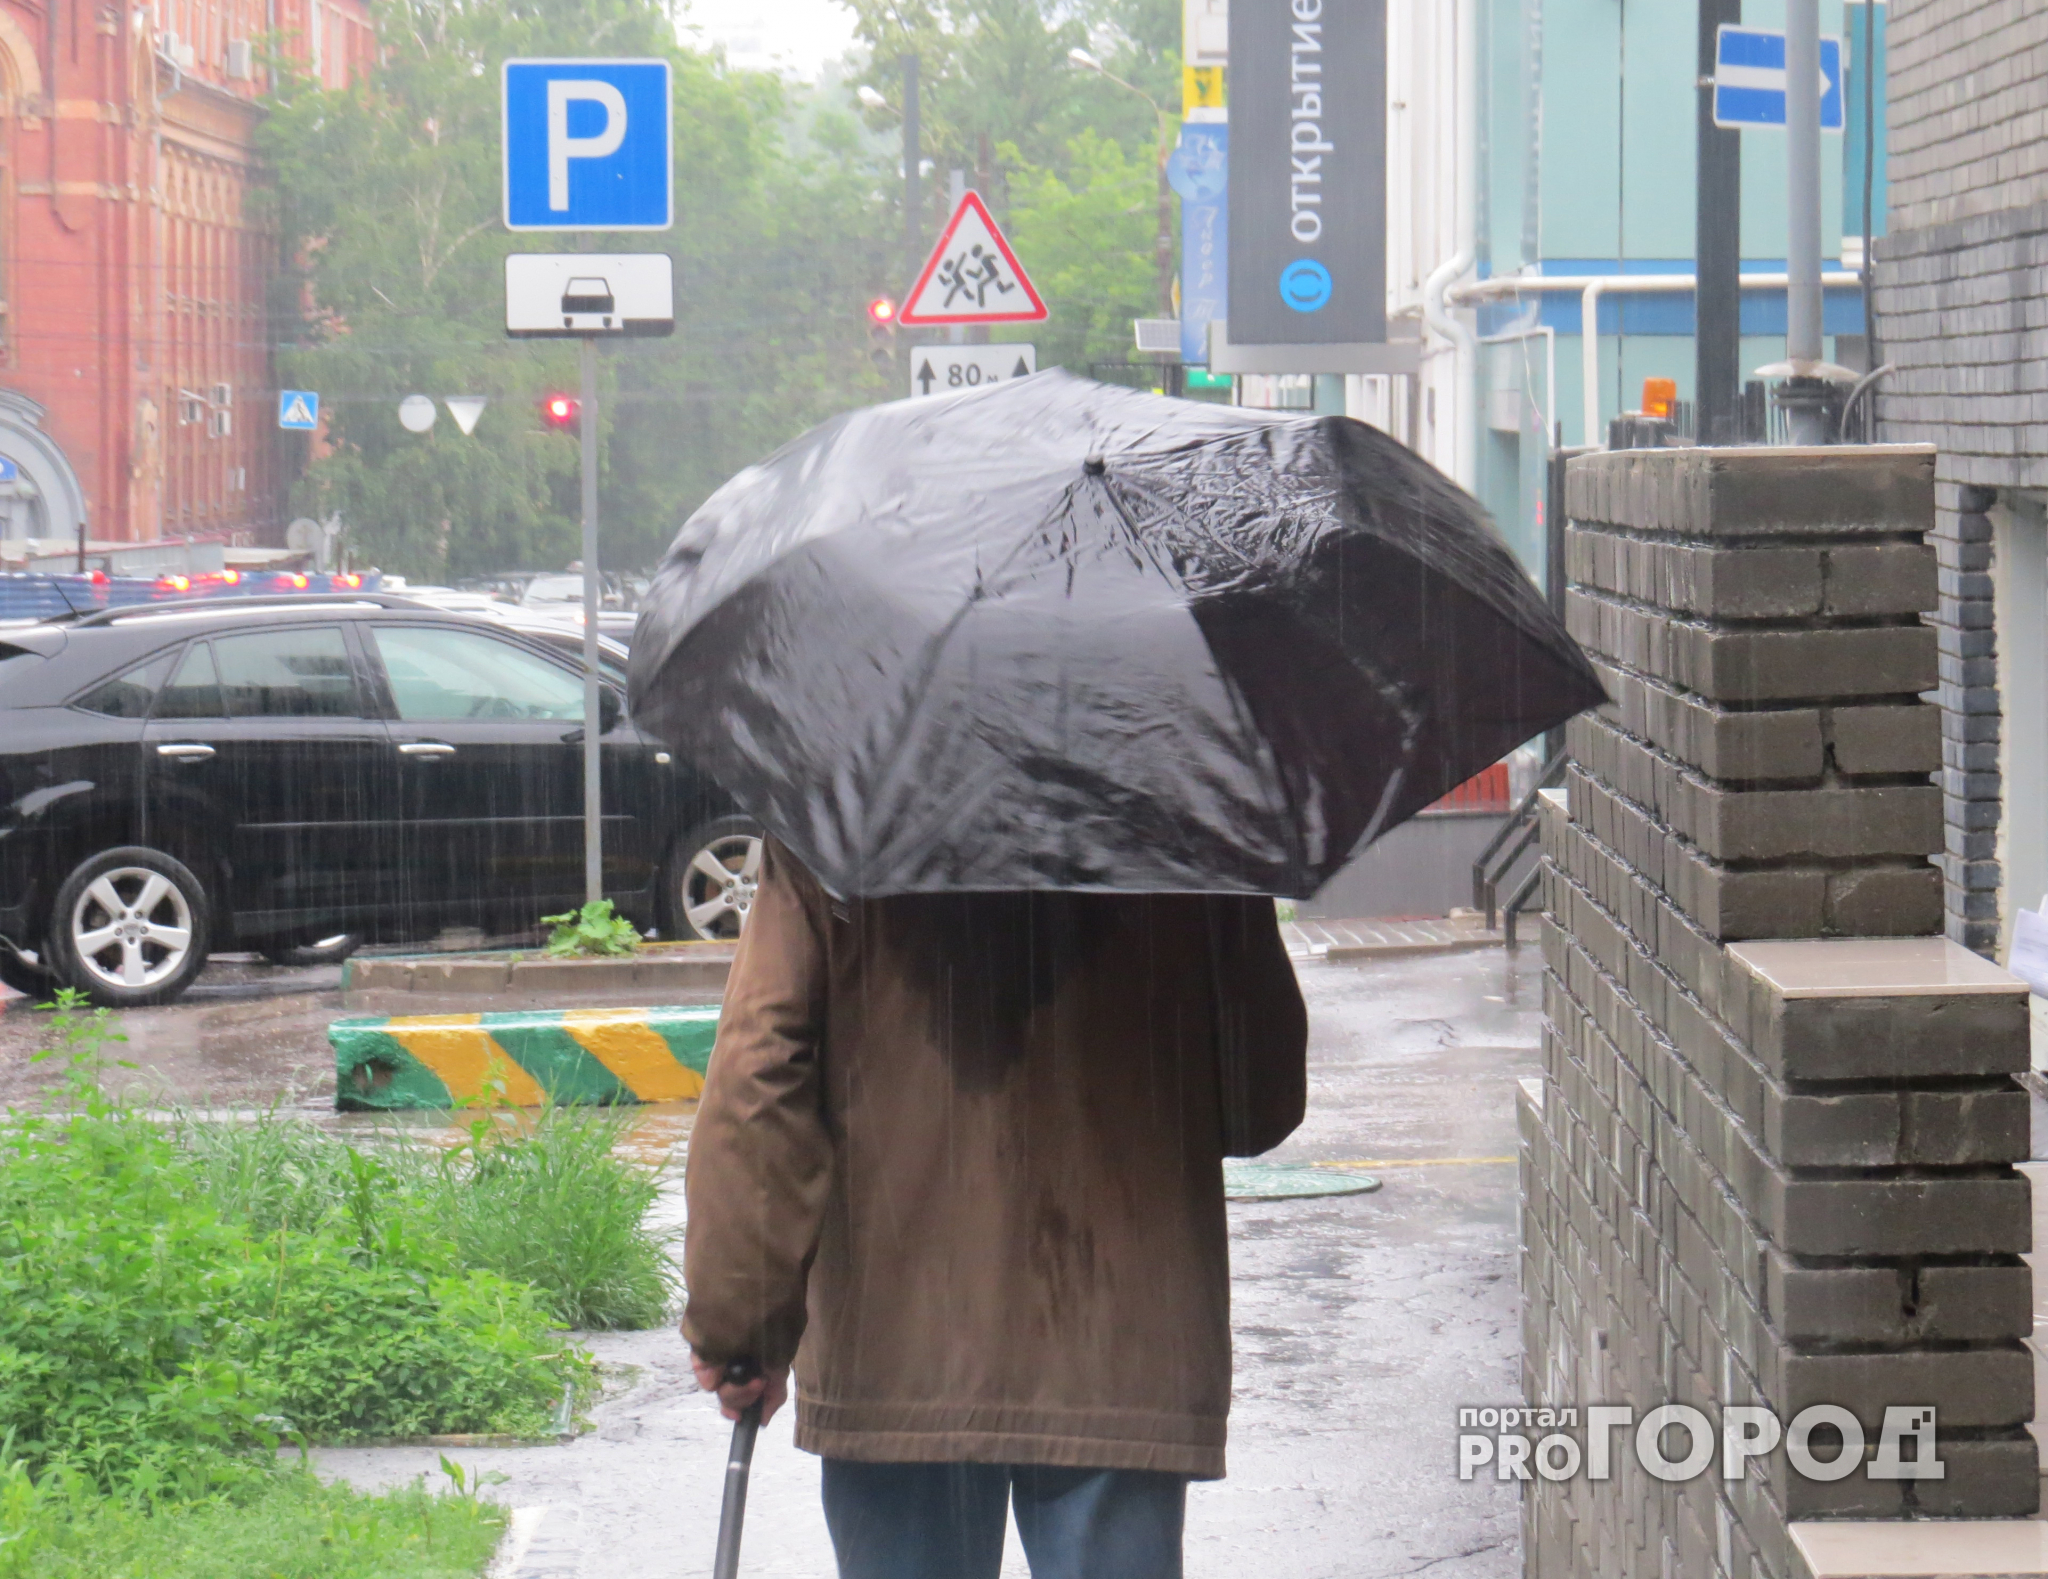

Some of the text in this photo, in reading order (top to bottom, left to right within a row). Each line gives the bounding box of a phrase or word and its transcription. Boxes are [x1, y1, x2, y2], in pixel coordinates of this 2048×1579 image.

[547, 79, 628, 212] P
[1291, 0, 1334, 243] открытие
[948, 363, 981, 387] 80
